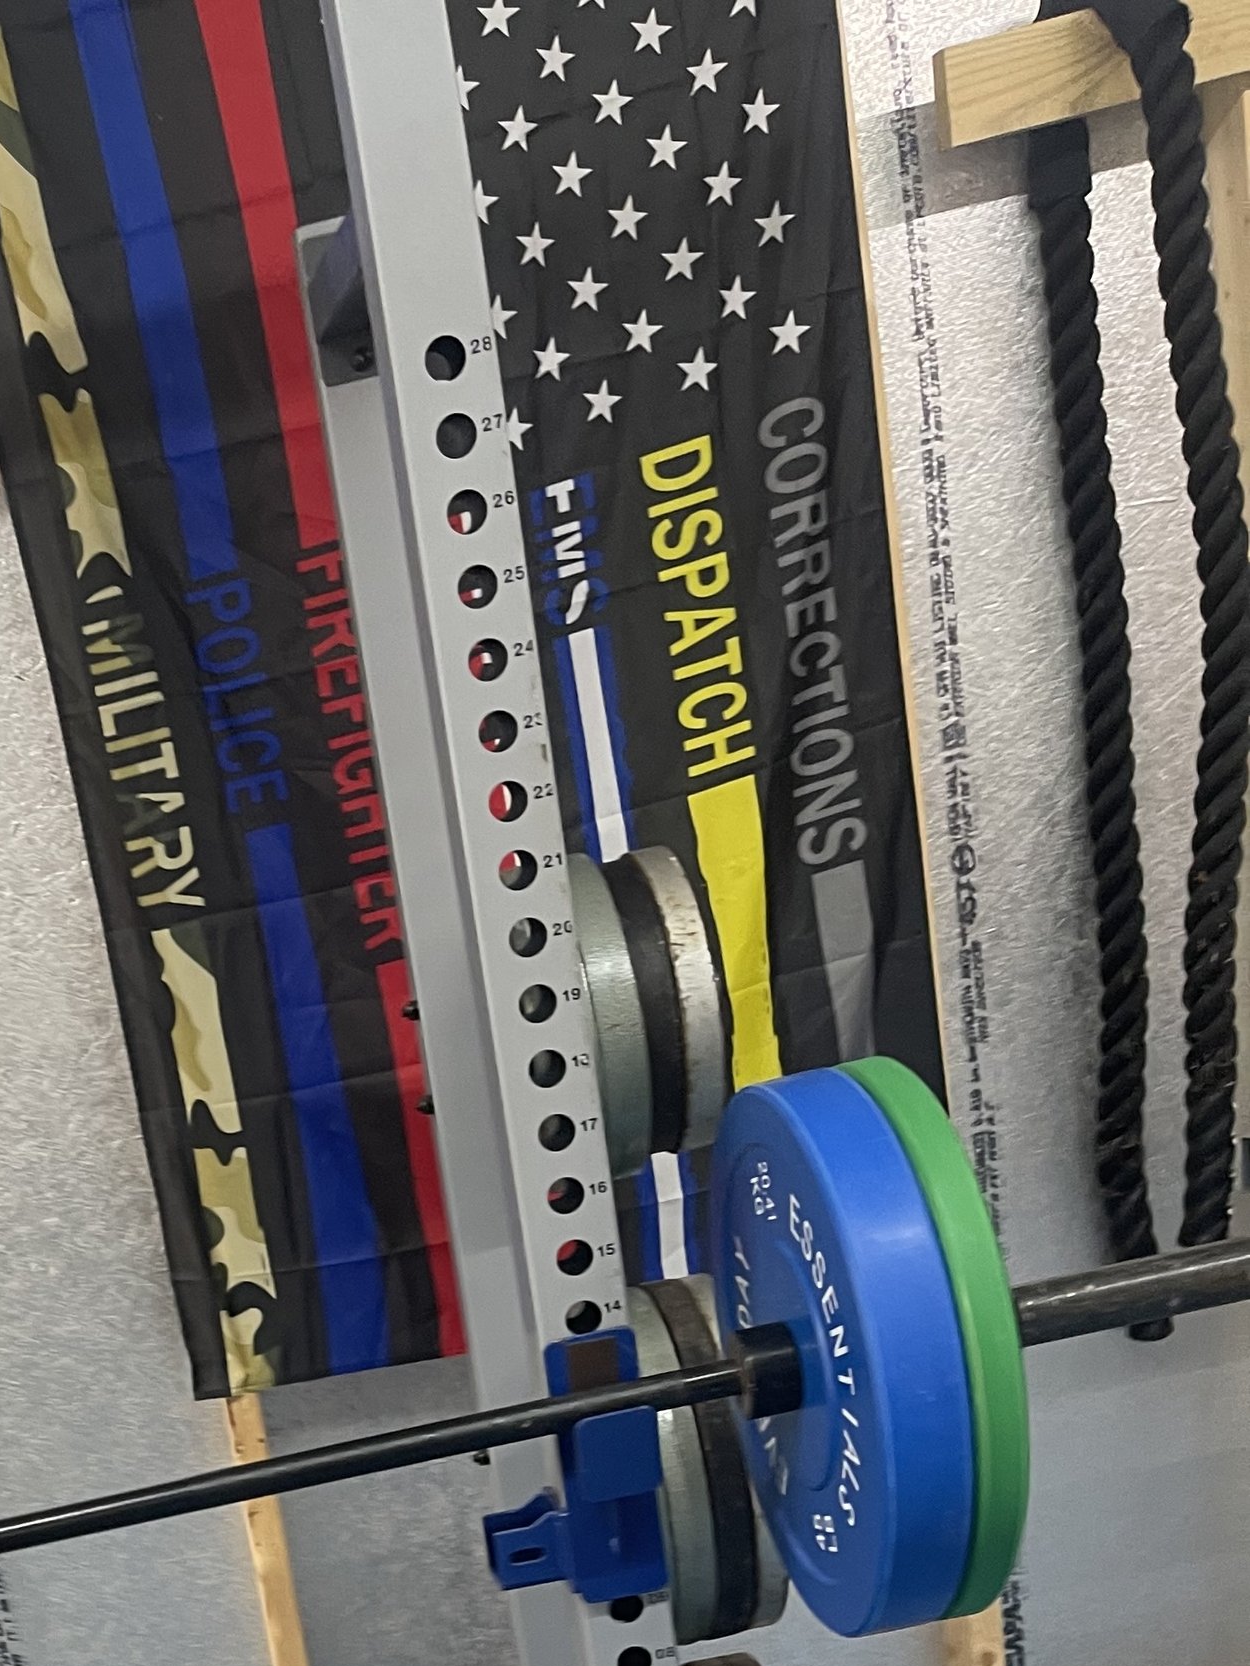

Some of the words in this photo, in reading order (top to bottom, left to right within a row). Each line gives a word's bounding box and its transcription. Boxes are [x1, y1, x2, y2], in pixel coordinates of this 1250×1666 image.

[470, 336, 492, 354] 28
[482, 414, 503, 432] 27
[493, 491, 514, 508] 26
[530, 472, 610, 626] EMS
[503, 566, 525, 583] 25
[639, 434, 757, 778] DISPATCH
[758, 396, 869, 866] CORRECTIONS
[513, 640, 534, 657] 24
[184, 577, 292, 814] POLICE
[81, 612, 207, 907] MILITARY
[533, 783, 554, 799] 22
[543, 853, 563, 868] 21
[562, 987, 581, 1002] 19
[580, 1118, 598, 1132] 17
[588, 1182, 607, 1195] 16
[597, 1243, 616, 1257] 15
[603, 1301, 622, 1313] 14
[788, 1192, 862, 1527] ESSENTIALS
